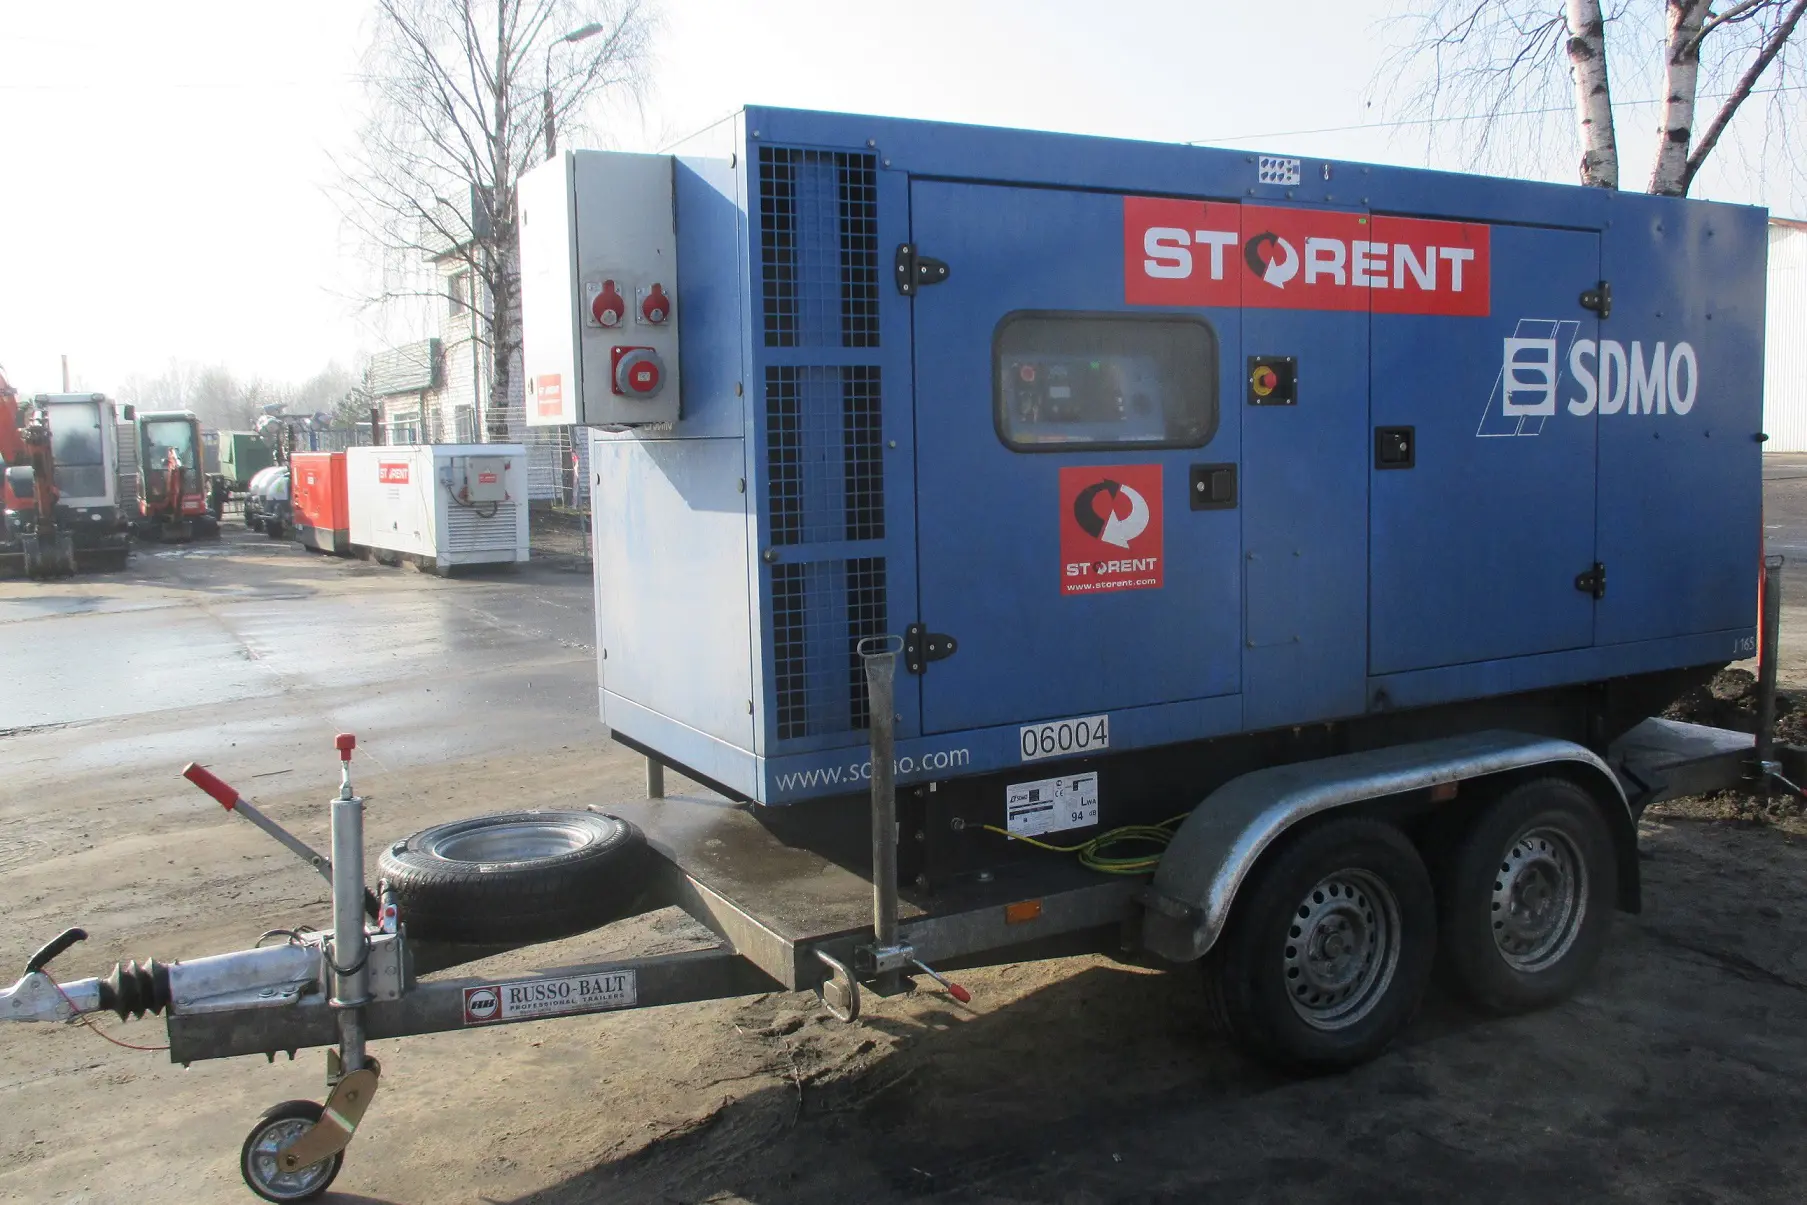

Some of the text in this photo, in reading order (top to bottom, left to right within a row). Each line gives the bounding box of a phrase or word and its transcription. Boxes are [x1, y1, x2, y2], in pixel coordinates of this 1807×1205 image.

[1567, 339, 1698, 417] SDMO
[1066, 578, 1156, 591] www.storent.com
[1022, 719, 1108, 757] 06004
[1071, 809, 1097, 823] 94 dB
[509, 975, 626, 1004] RUSSO-BALT
[509, 1000, 576, 1011] PROFESSIONAL
[582, 993, 625, 1003] TRAILERS
